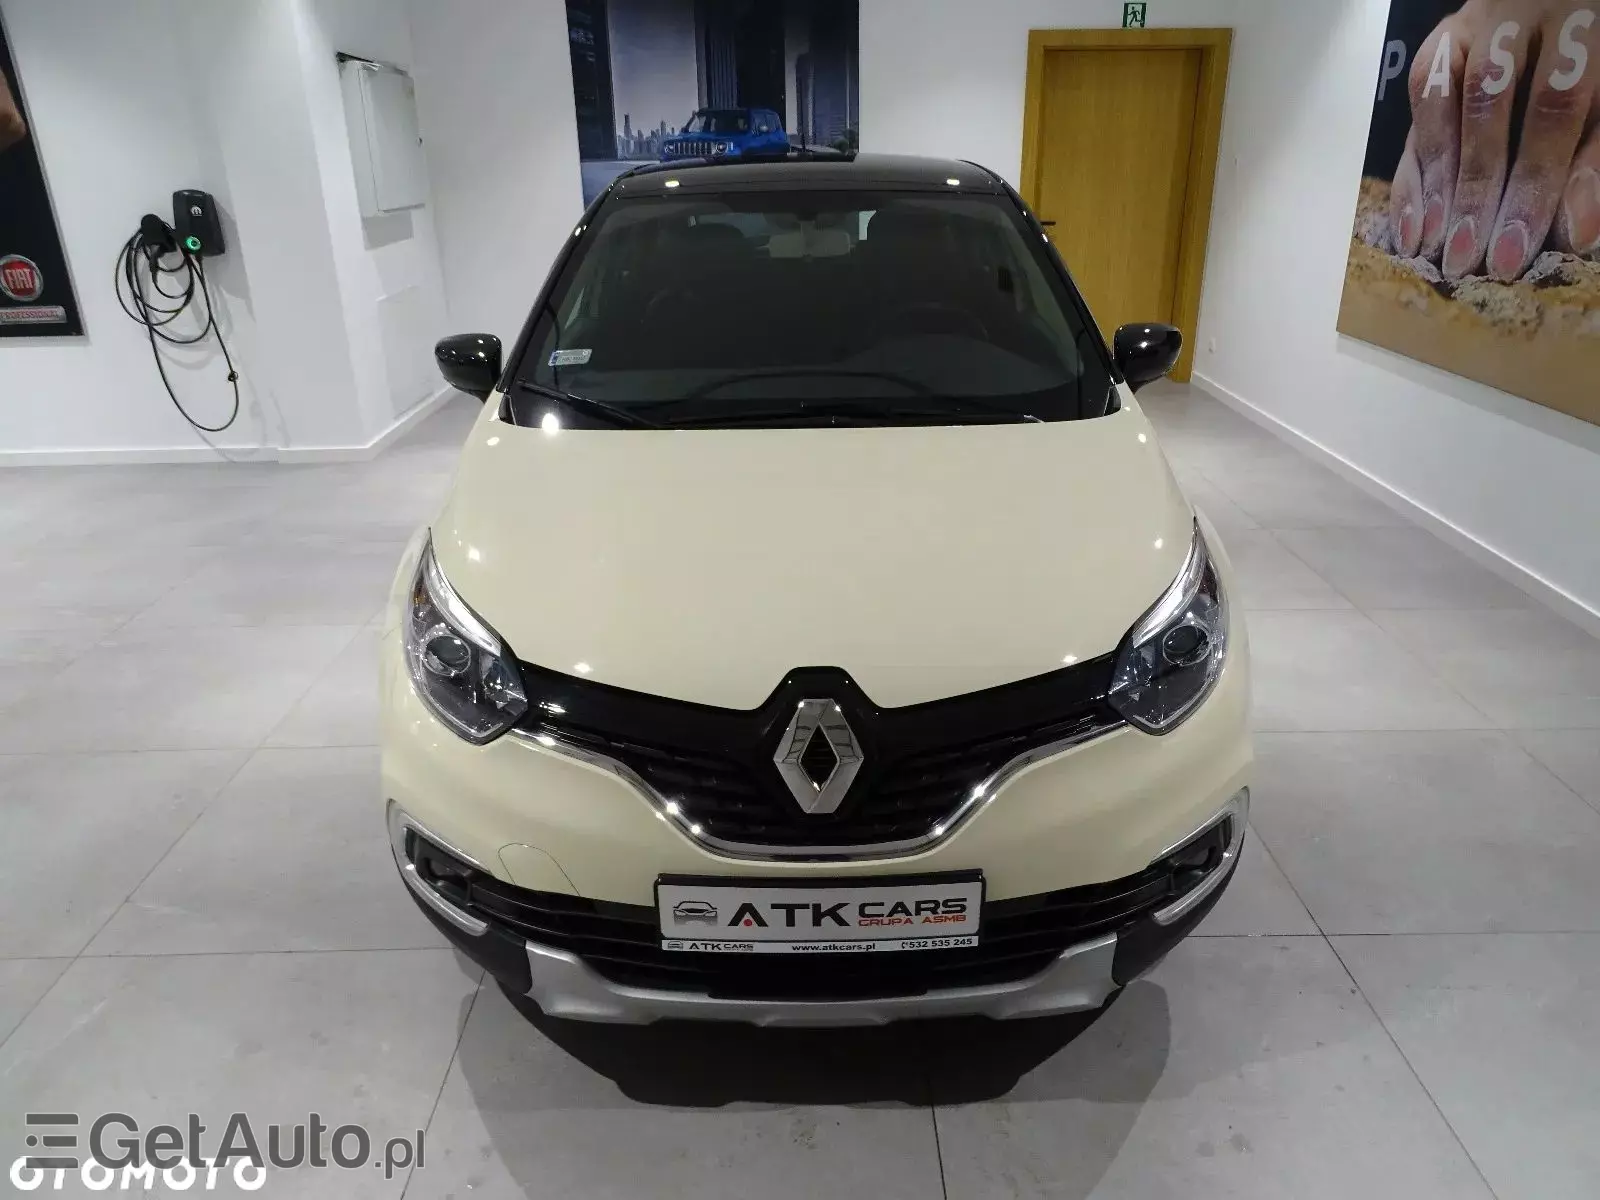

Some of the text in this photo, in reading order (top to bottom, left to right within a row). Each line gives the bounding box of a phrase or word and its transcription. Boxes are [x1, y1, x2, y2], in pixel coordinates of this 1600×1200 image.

[1378, 9, 1596, 101] PASS
[4, 268, 33, 289] FIAT
[727, 897, 967, 927] ATK CARS
[858, 914, 967, 927] GRUPA ASMB
[688, 942, 722, 951] ATK
[791, 942, 876, 952] www.atkcars.pl
[908, 941, 928, 949] 532
[931, 939, 951, 948] 535
[953, 938, 973, 946] 245
